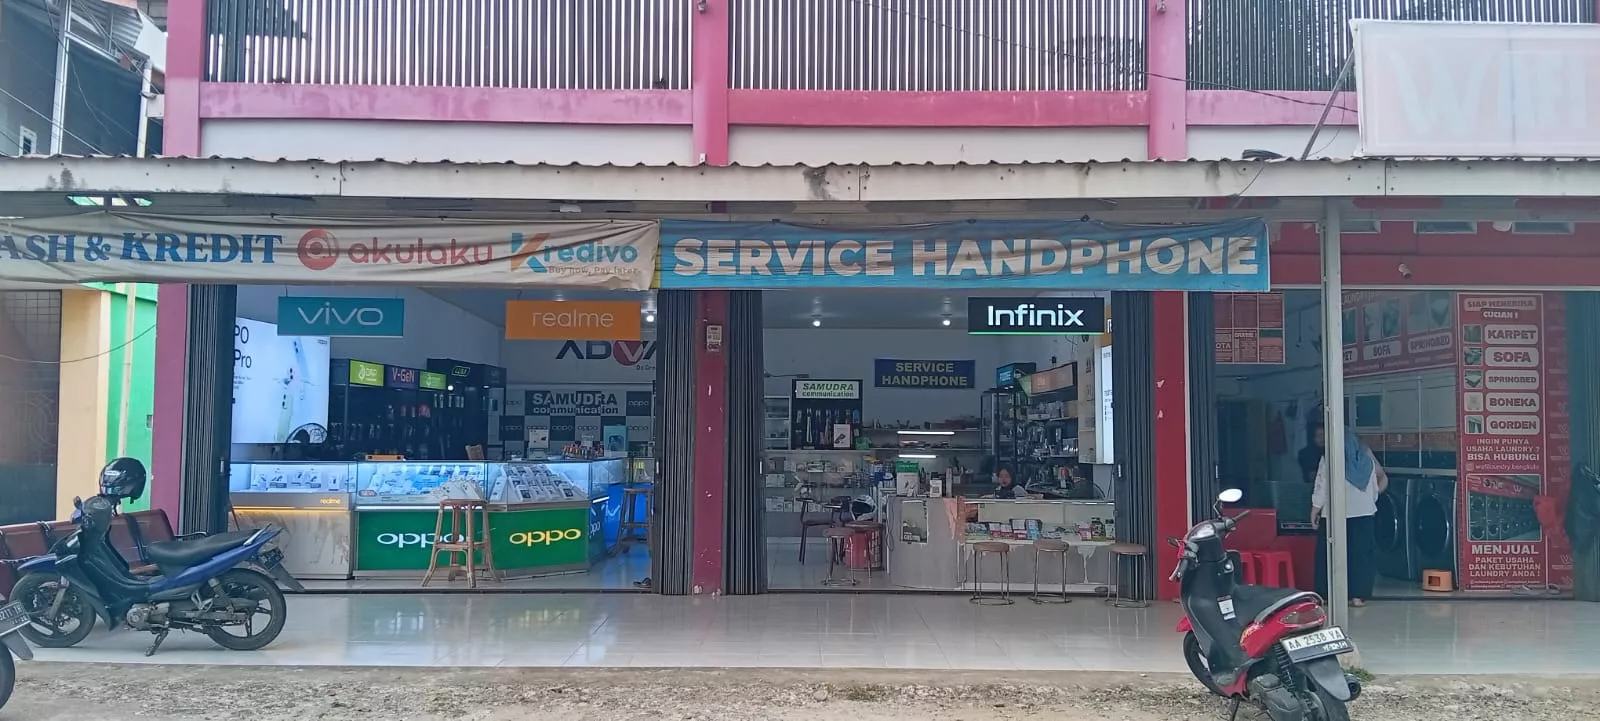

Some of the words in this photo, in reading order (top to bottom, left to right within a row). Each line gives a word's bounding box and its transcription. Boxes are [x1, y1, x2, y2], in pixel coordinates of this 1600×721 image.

[83, 233, 112, 262] &
[119, 233, 283, 263] KREDIT
[347, 236, 494, 266] akulaku
[510, 232, 639, 274] Kredivo
[673, 239, 895, 277] SERVICE
[912, 237, 1259, 277] HANDPHONE
[297, 302, 384, 326] vivo
[532, 309, 614, 328] realme
[986, 304, 1084, 327] Infinix
[1487, 330, 1536, 339] KARPET
[1493, 352, 1532, 363] SOFA
[895, 362, 954, 373] SERVICE
[802, 382, 854, 391] SAMUDRA
[881, 376, 968, 386] HANDPHONE
[532, 393, 618, 406] SAMUDRA
[1489, 398, 1536, 407] BONEKA
[533, 406, 619, 415] communication
[1490, 421, 1537, 430] GORDEN
[1467, 453, 1491, 461] BISA
[1493, 453, 1540, 461] HUBUNGI
[509, 528, 582, 547] oppo
[1471, 545, 1539, 555] MENJUAL
[1288, 640, 1302, 649] AA
[1304, 632, 1326, 645] 2538
